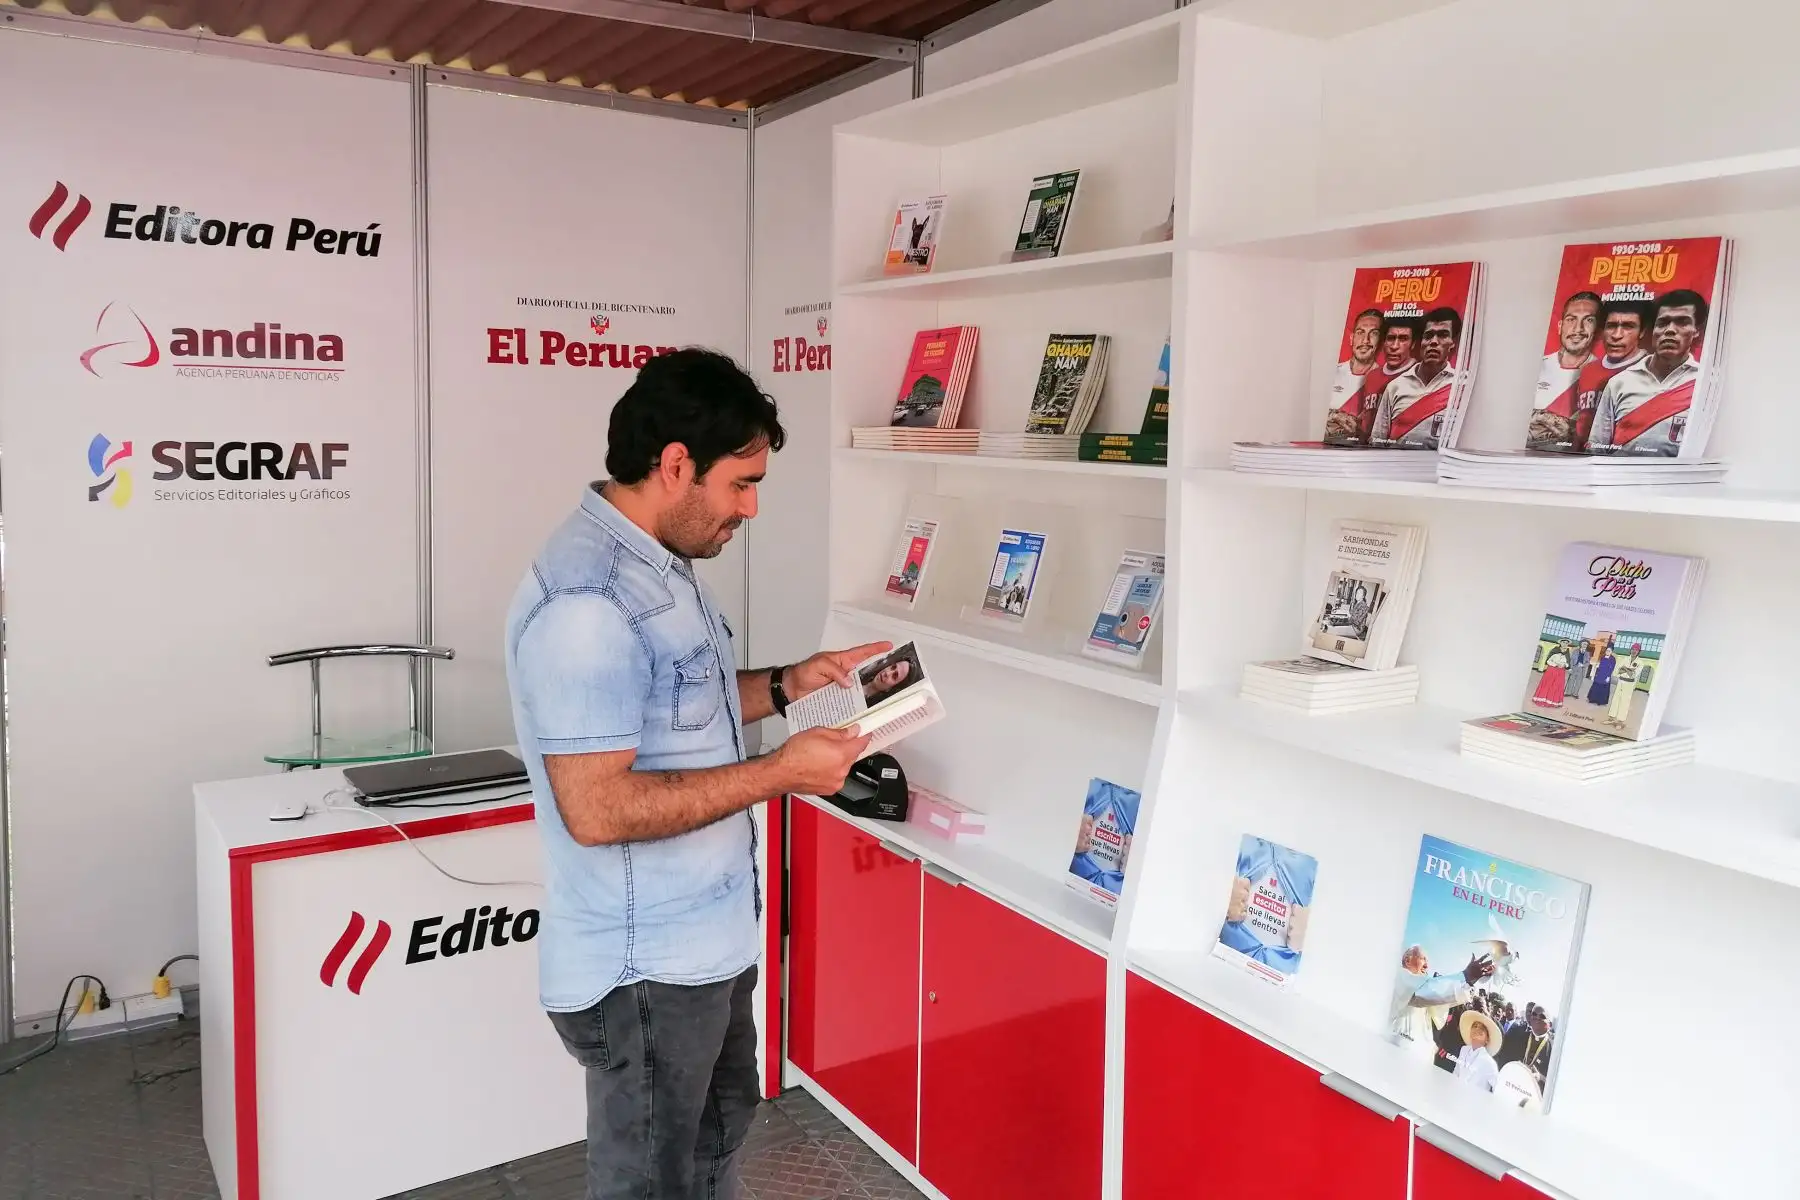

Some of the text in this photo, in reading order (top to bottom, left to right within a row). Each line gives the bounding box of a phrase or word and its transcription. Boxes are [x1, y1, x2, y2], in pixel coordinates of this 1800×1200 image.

[104, 203, 382, 257] Editora Perú
[1611, 243, 1662, 255] 1930-2018
[1393, 268, 1430, 278] 1930-2018
[1589, 245, 1679, 285] PERÚ
[1375, 270, 1443, 303] PERÚ
[1613, 283, 1646, 293] EN LOS
[1601, 292, 1655, 302] MUNDIALES
[517, 296, 676, 315] DIARIO OFICIAL DEL BICENTENARIO
[1383, 309, 1424, 318] MUNDIALES
[1403, 302, 1417, 310] LOS
[170, 322, 344, 362] andina
[487, 328, 680, 369] El Perua
[773, 336, 790, 372] El
[176, 368, 340, 382] AGENCIA PERUANA DE NOTICIAS
[152, 440, 349, 481] SEGRAF
[154, 488, 350, 503] Servicios Editoriales y Gráficos
[1343, 535, 1389, 547] SABIHONDAS
[1344, 545, 1391, 559] INDISCRETAS
[1099, 821, 1113, 832] Saca
[1091, 839, 1102, 848] que
[1096, 830, 1120, 844] escritor
[1093, 849, 1113, 862] dentro
[1259, 885, 1286, 903] Saca al
[1423, 854, 1567, 919] FRANCISCO
[1255, 897, 1286, 915] escritor
[1453, 886, 1526, 920] EN EL PERÚ
[1248, 906, 1286, 928] que llevas
[1252, 918, 1278, 935] dentro
